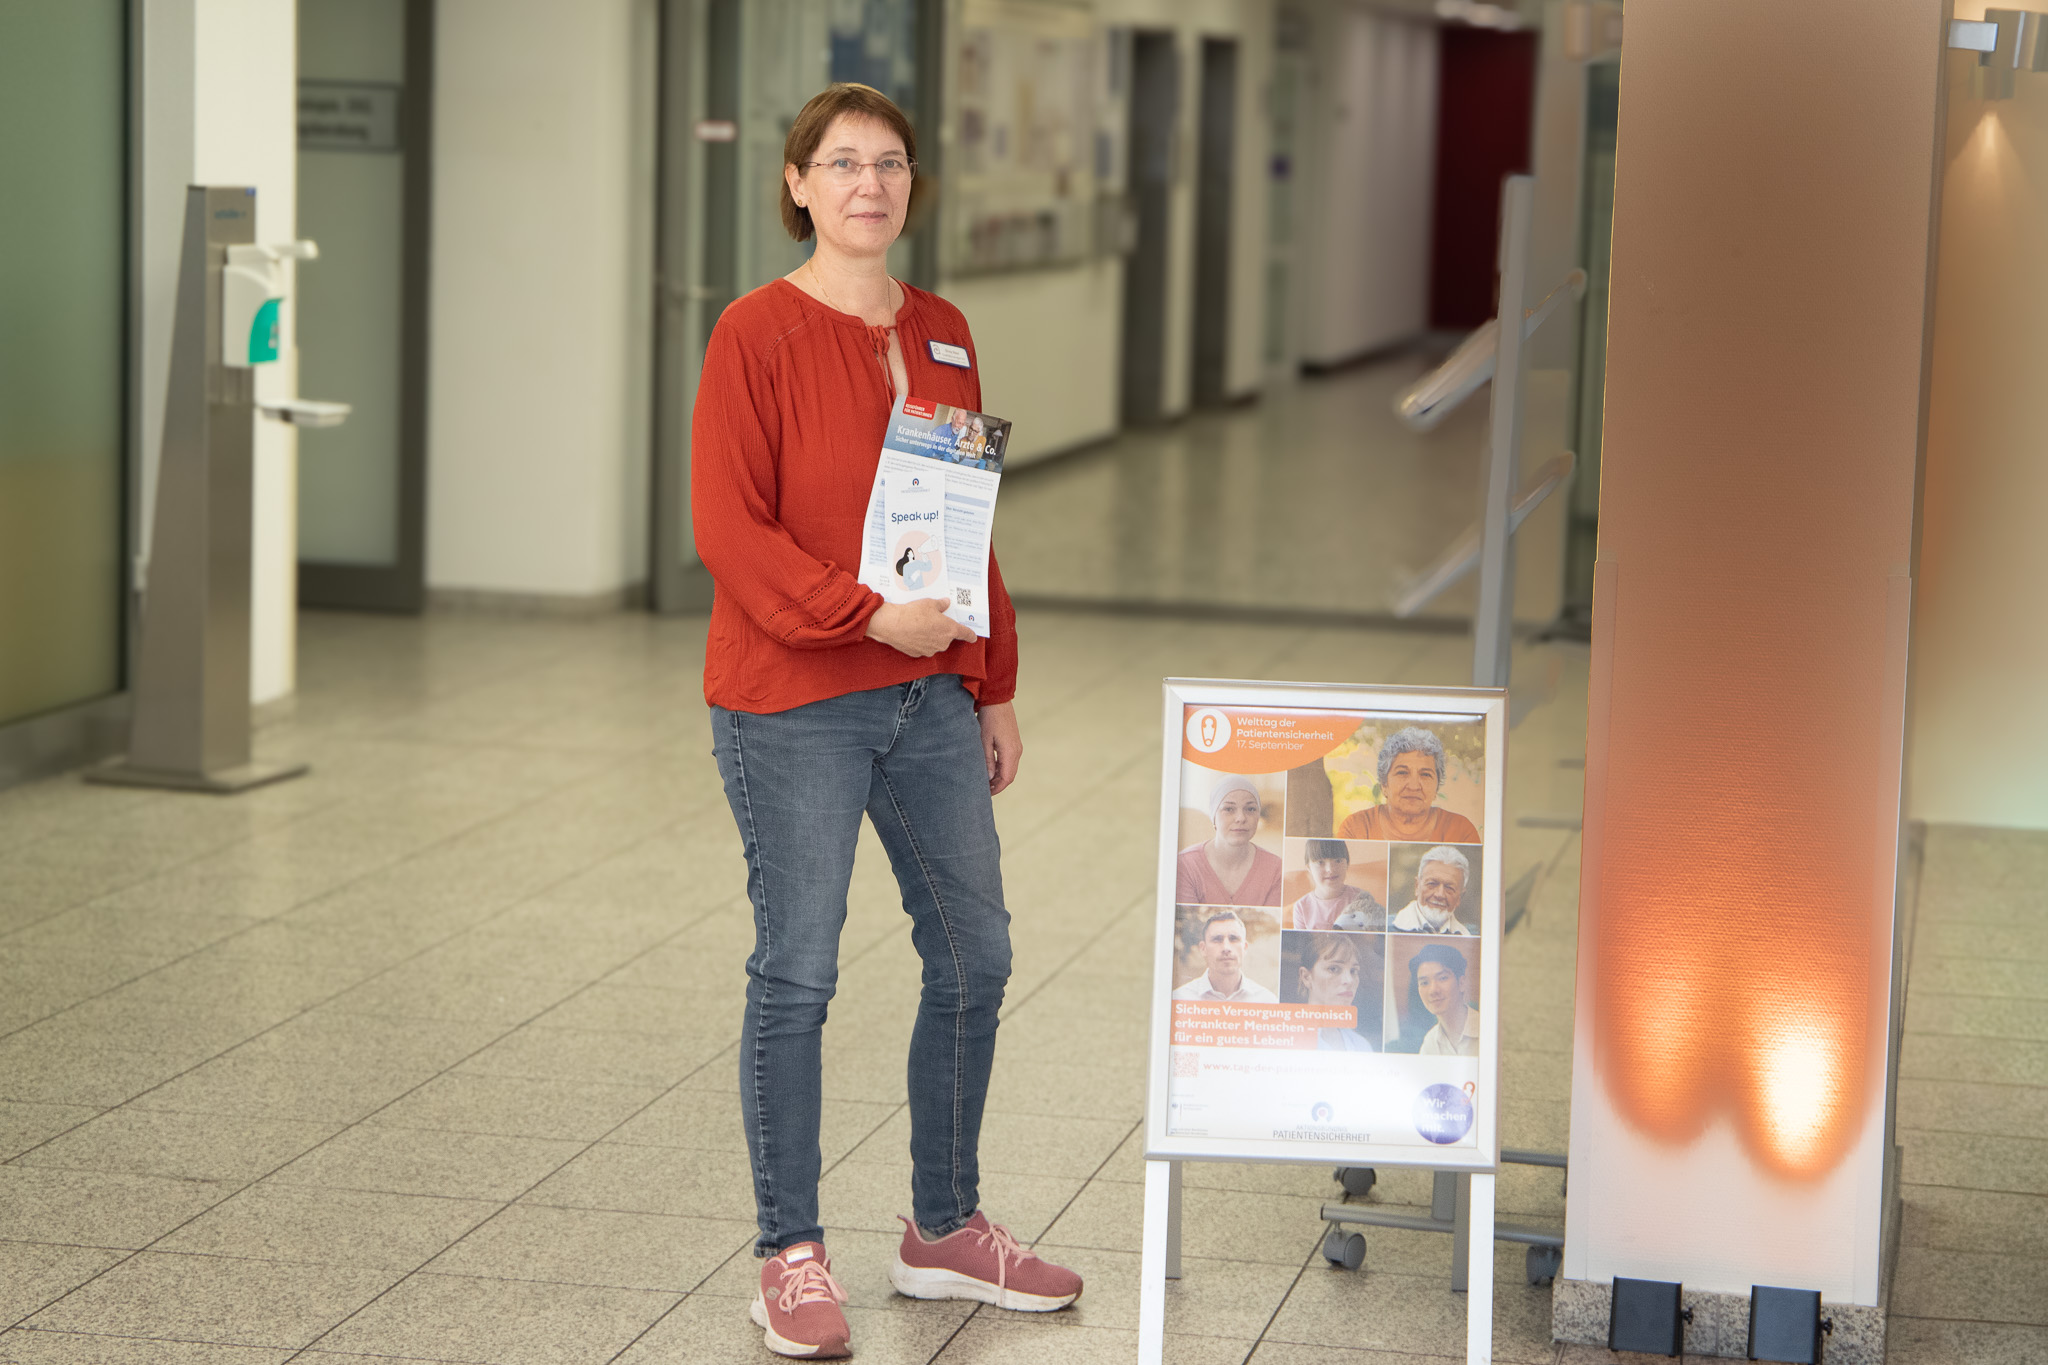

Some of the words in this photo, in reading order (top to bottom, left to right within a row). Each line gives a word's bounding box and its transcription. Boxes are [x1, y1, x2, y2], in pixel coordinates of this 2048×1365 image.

[895, 435, 909, 444] Sicher
[909, 439, 932, 450] unterwegs
[897, 424, 952, 446] Krankenhäuser,
[954, 435, 975, 450] Ärzte
[976, 442, 983, 453] &
[985, 444, 996, 456] Co.
[891, 511, 922, 525] Speak
[923, 510, 939, 523] up!
[1237, 717, 1278, 728] Welttag
[1279, 717, 1296, 728] der
[1236, 728, 1334, 741] Patientensicherheit
[1236, 740, 1247, 749] 17.
[1248, 740, 1304, 751] September
[1175, 1004, 1221, 1016] Sichere
[1222, 1005, 1291, 1020] Versorgung
[1294, 1009, 1352, 1021] chronisch
[1174, 1018, 1241, 1030] erkrankter
[1244, 1021, 1304, 1033] Menschen
[1174, 1032, 1192, 1043] für
[1195, 1034, 1213, 1043] ein
[1216, 1034, 1250, 1047] gutes
[1253, 1034, 1294, 1046] Leben!
[1423, 1098, 1445, 1108] Wir
[1422, 1111, 1467, 1121] machen
[1422, 1123, 1445, 1133] mit.
[1272, 1129, 1371, 1143] PATIENTENSICHERHEIT
